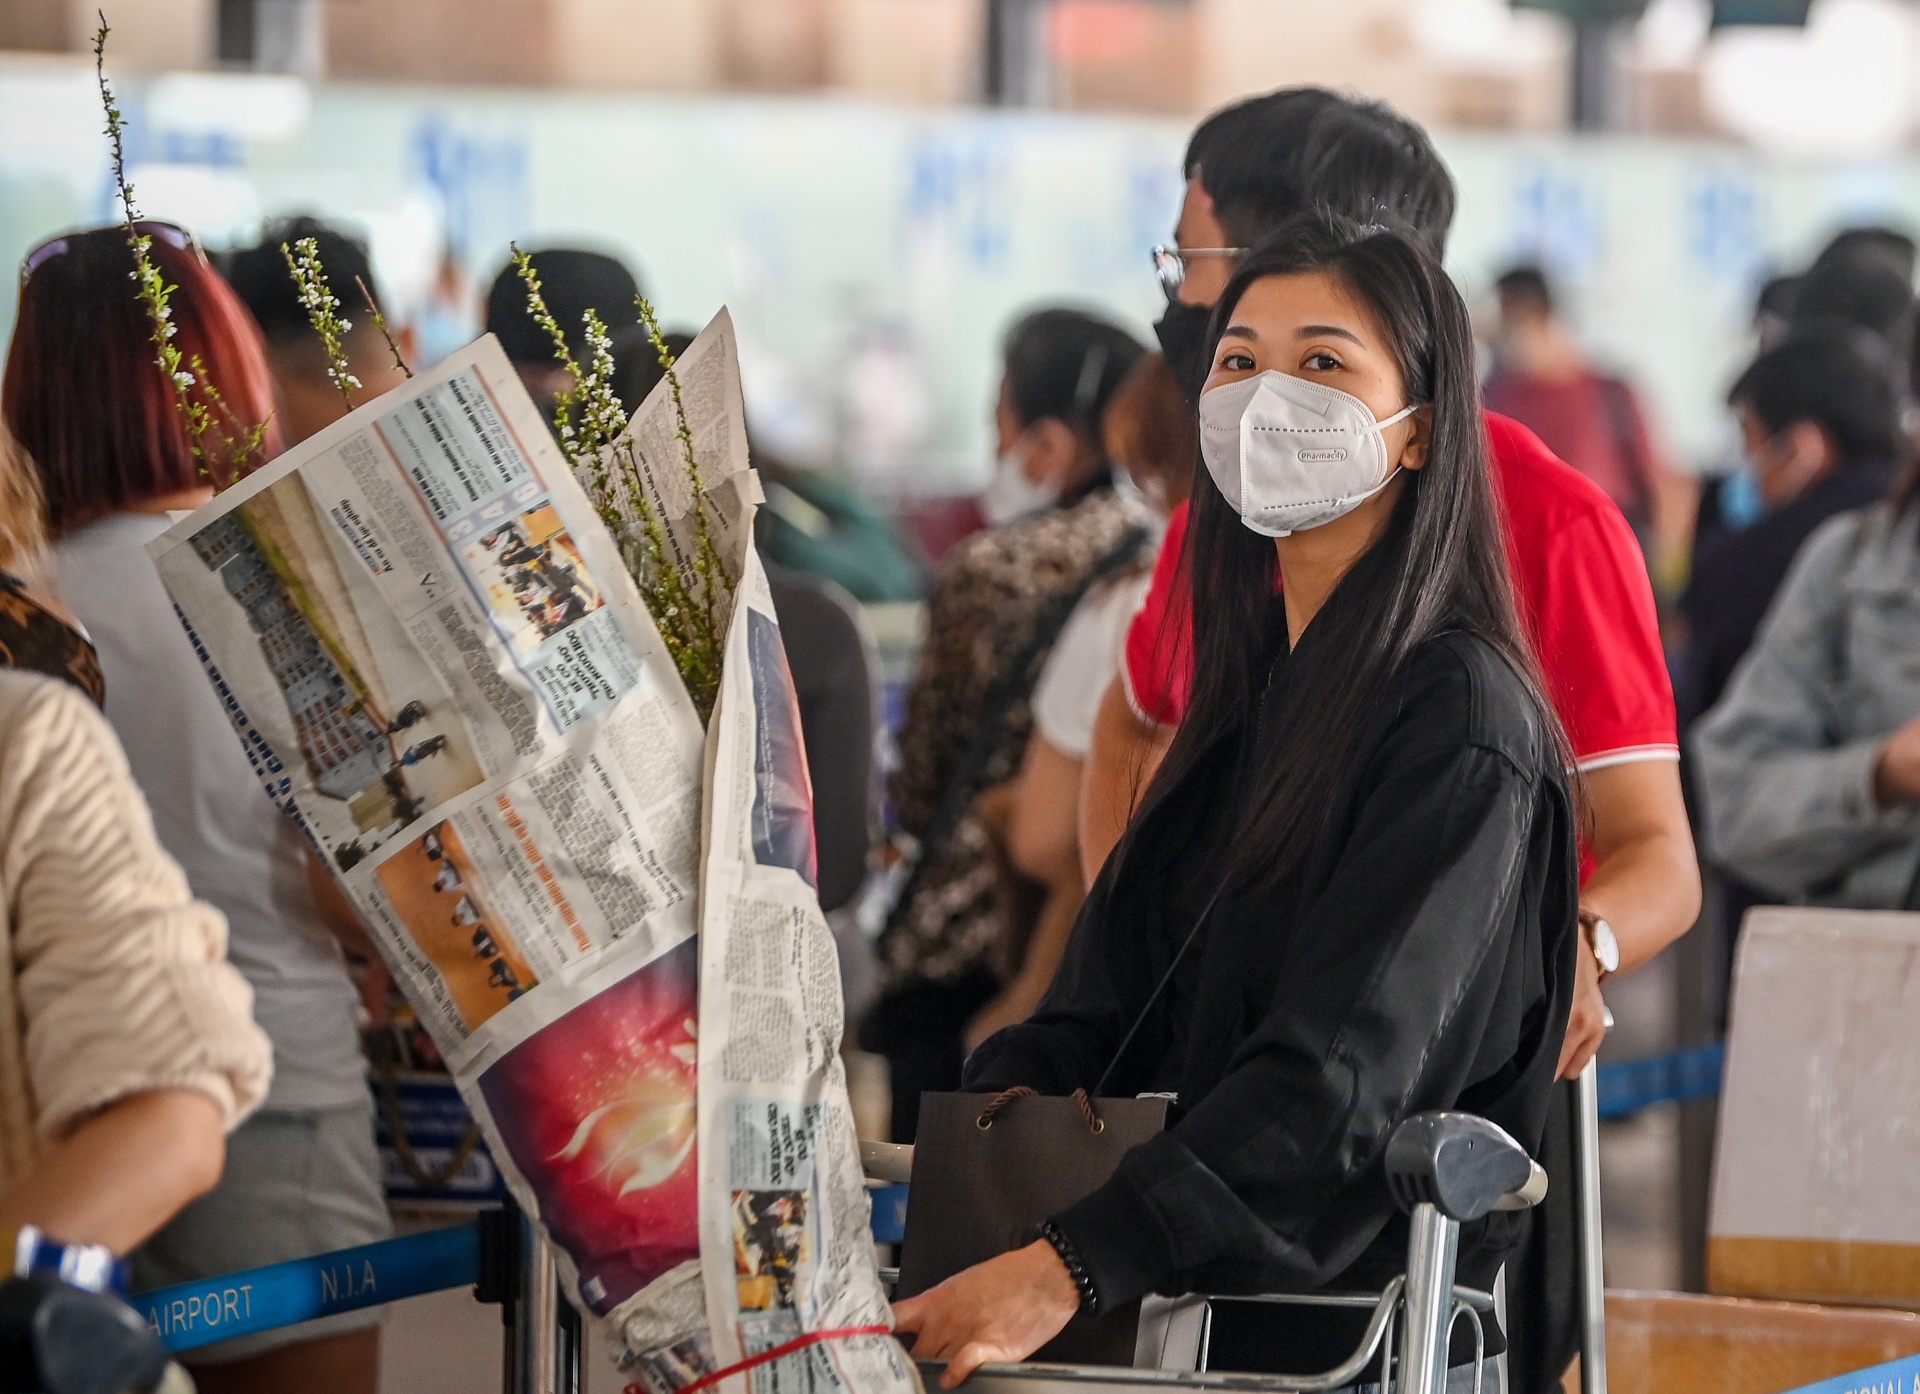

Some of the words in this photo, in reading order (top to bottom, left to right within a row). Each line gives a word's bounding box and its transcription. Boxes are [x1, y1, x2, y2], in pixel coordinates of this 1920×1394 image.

[1301, 450, 1344, 460] Pharmacity
[340, 499, 361, 526] nghiệp
[480, 500, 504, 519] 4
[448, 519, 473, 540] 3
[566, 629, 583, 651] HỌC
[545, 681, 560, 701] trung
[588, 753, 602, 773] khẩu
[599, 771, 612, 790] nhập
[150, 1285, 253, 1337] AIRPORT
[321, 1259, 376, 1304] N.I.A
